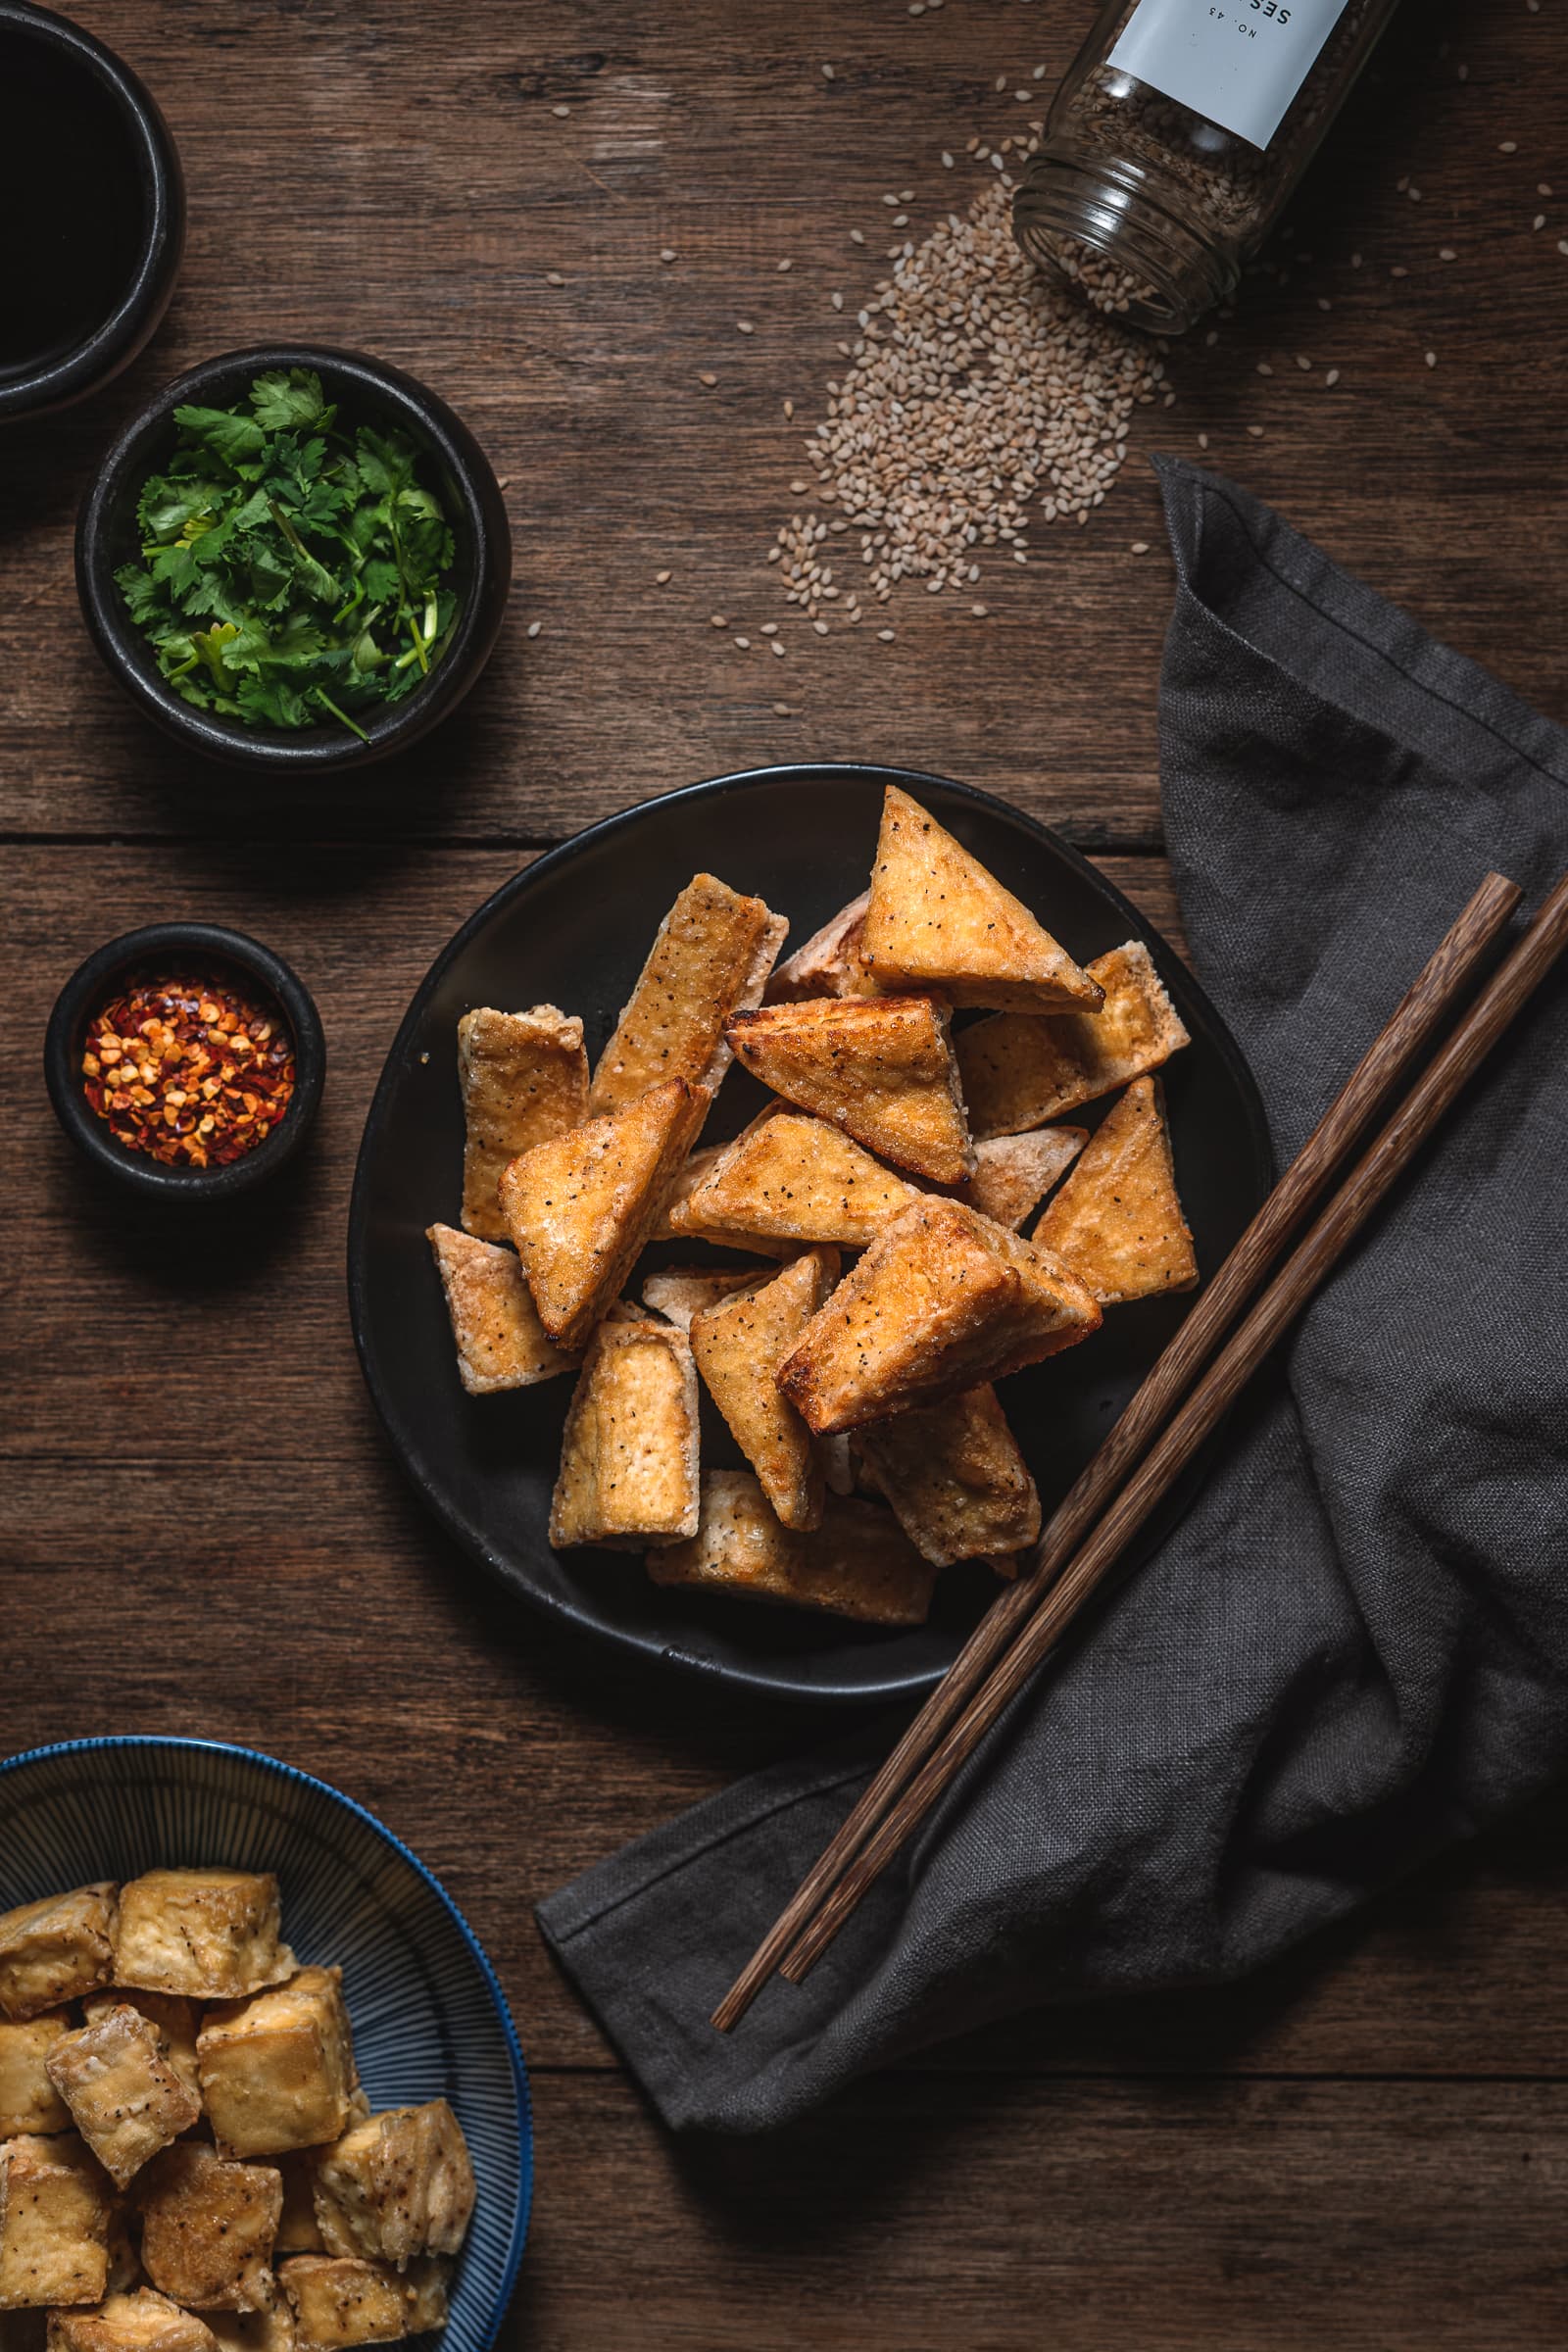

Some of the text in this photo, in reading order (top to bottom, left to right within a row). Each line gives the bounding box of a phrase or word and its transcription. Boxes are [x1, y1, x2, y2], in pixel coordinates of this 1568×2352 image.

[1208, 7, 1257, 38] NO. 43
[1240, 0, 1292, 24] SES
